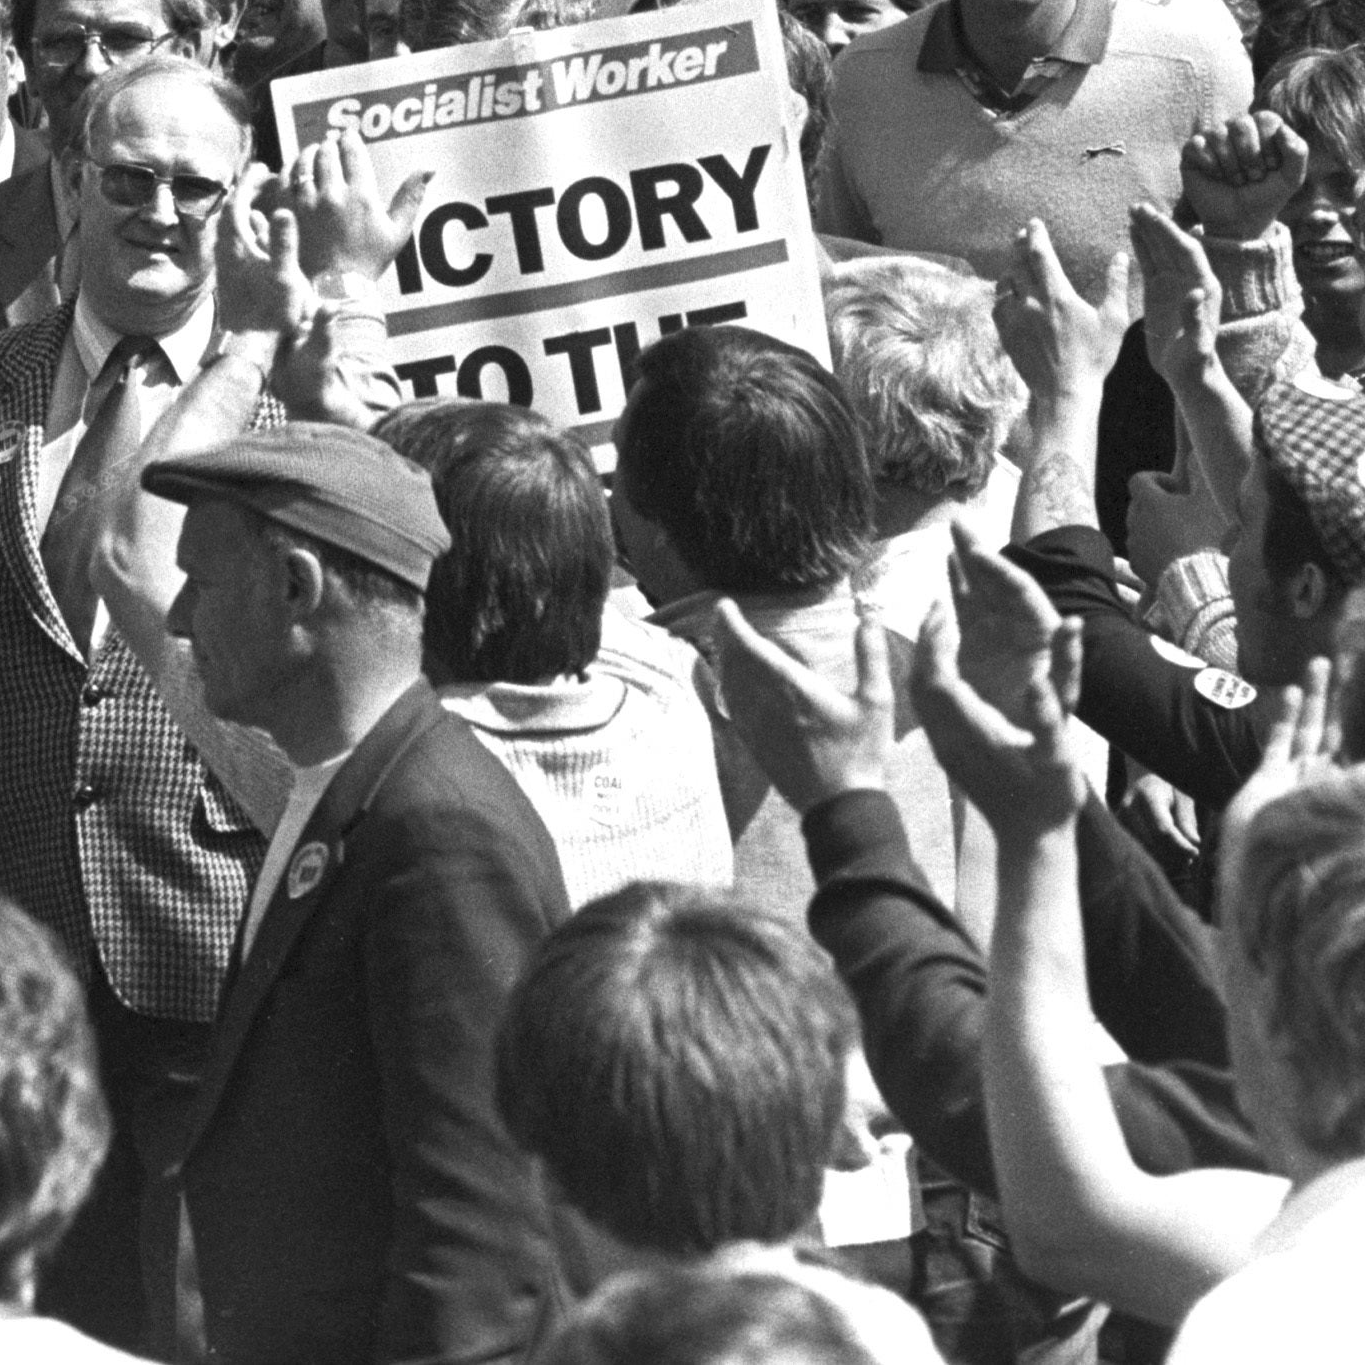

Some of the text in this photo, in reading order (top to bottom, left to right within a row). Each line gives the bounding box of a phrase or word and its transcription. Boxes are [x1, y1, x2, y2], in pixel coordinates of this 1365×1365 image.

[327, 41, 727, 137] Socialist Worker
[388, 145, 771, 295] ICTORY
